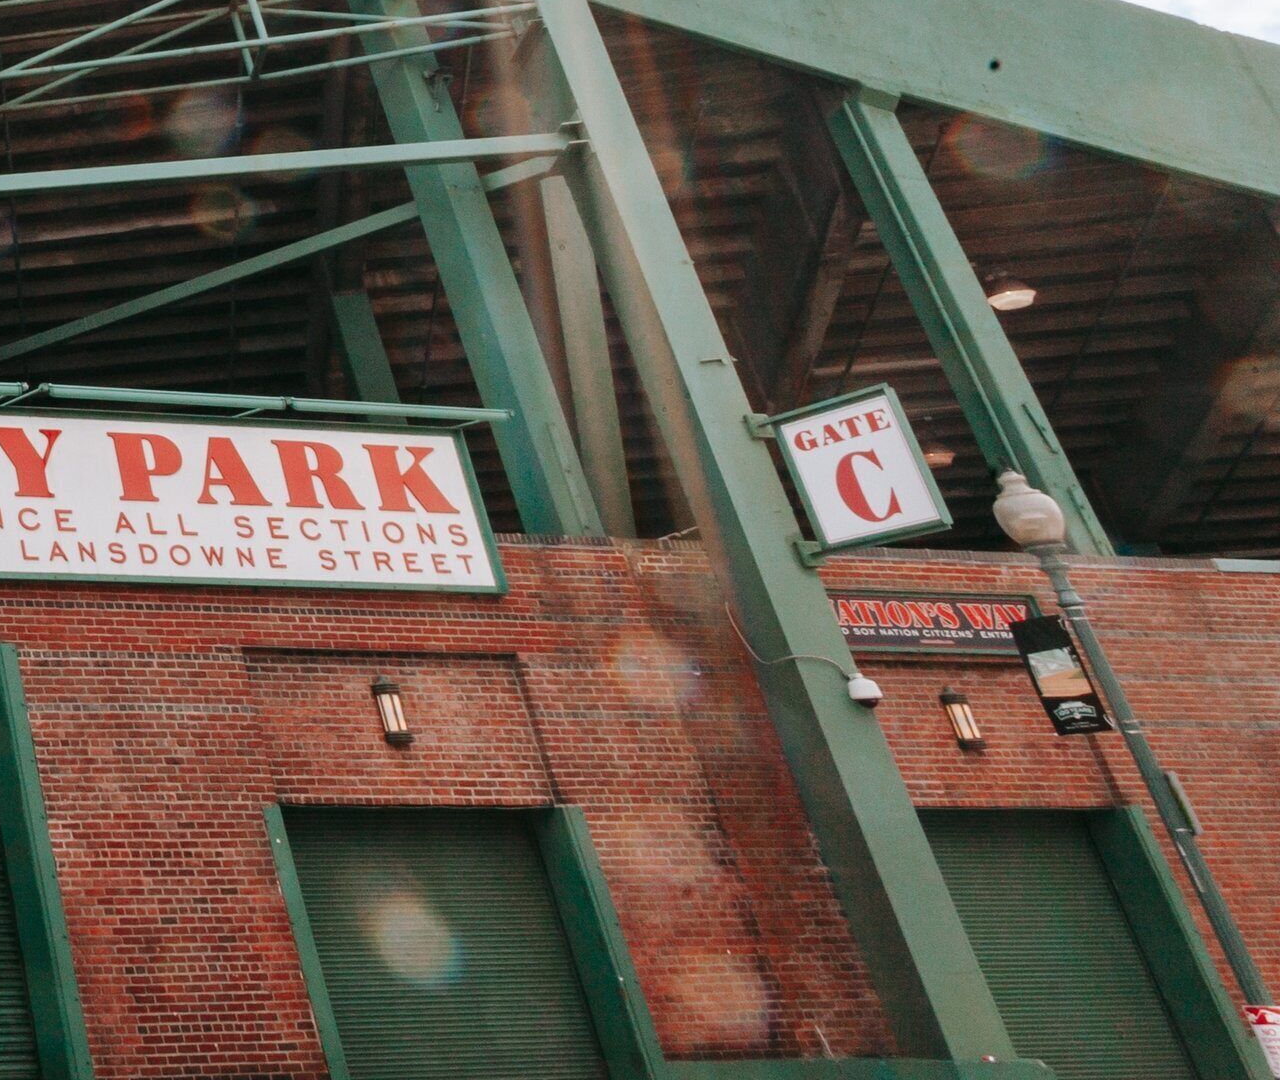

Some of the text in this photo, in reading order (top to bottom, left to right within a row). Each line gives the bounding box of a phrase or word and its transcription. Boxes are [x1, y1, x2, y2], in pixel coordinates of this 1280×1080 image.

[794, 408, 891, 452] GATE
[106, 431, 461, 514] PARK
[836, 448, 902, 522] C
[115, 512, 198, 536] ALL
[234, 515, 469, 547] SECTIONS
[22, 539, 287, 569] LANSDOWNE
[318, 549, 474, 575] STREET
[852, 627, 876, 636] SOX
[879, 627, 920, 637] NATION
[922, 628, 975, 639] CITIZENS'
[957, 602, 1026, 631] WAY
